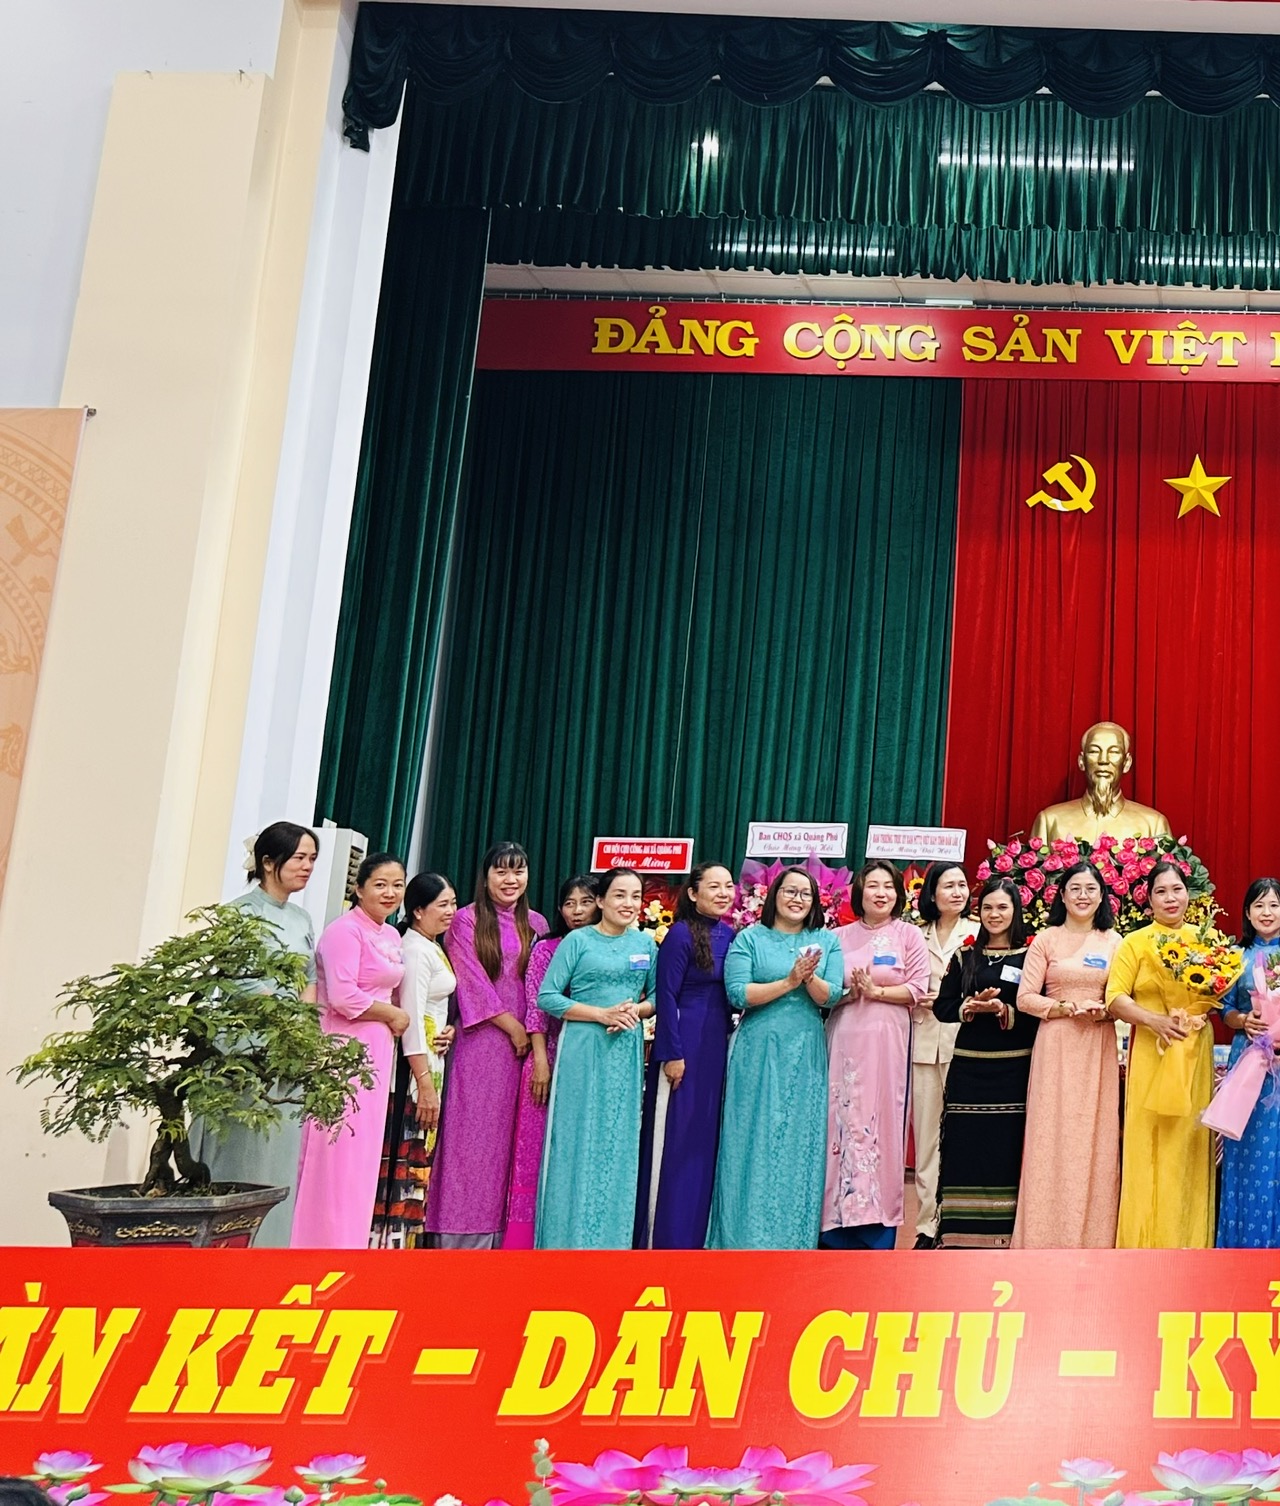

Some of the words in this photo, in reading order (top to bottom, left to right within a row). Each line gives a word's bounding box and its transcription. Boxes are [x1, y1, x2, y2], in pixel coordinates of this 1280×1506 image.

[592, 306, 759, 358] ĐẢNG
[784, 313, 940, 371] CỘNG
[962, 314, 1082, 364] SẢN
[1105, 319, 1248, 374] VIỆT
[758, 832, 771, 841] Ban
[773, 832, 792, 842] CHQS
[794, 833, 801, 841] xã
[803, 832, 824, 842] Quảng
[826, 832, 838, 841] Phú
[610, 856, 637, 867] Chúc
[639, 856, 671, 869] Mừng
[129, 1271, 397, 1416] KẾT
[498, 1287, 764, 1418] DÂN
[789, 1281, 1025, 1419] CHỦ
